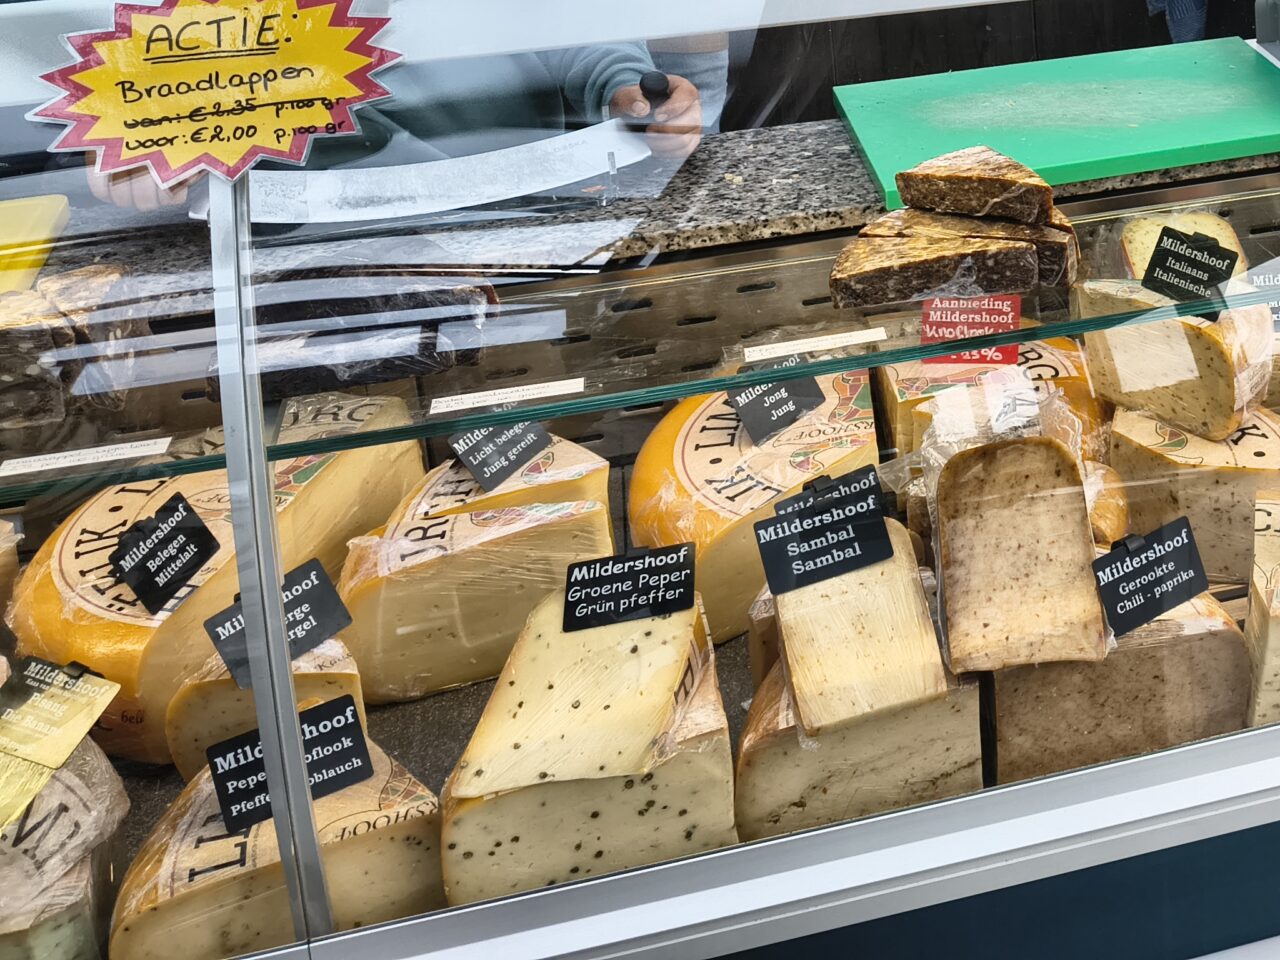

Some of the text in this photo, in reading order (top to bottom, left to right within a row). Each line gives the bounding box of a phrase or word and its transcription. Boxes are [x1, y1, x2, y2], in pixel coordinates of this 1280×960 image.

[145, 7, 298, 55] ACTIE:
[115, 66, 314, 104] Braadlappen
[1160, 236, 1231, 271] Mildershoof
[1165, 257, 1210, 282] Italiaans
[1154, 267, 1213, 298] Italienische
[928, 311, 1015, 324] Mildershoof
[932, 297, 1012, 313] Aanbieding
[763, 386, 788, 408] Jong
[770, 399, 796, 421] Jung
[469, 443, 497, 466] Licht
[483, 432, 538, 478] Jung gereift
[757, 495, 876, 544] Mildershoof
[119, 503, 187, 573] Mildershoof
[146, 533, 187, 573] Belegen
[786, 524, 856, 557] Sambal
[154, 543, 199, 588] Mittelalt
[570, 546, 689, 583] Mildershoof
[791, 542, 862, 575] Sambal
[1096, 528, 1189, 586] Mildershoof
[567, 569, 691, 602] Groene Peper
[1116, 592, 1145, 615] Chili
[1154, 569, 1196, 599] paprika
[1118, 561, 1176, 596] Gerookte
[575, 587, 684, 617] Grün pfeffer
[24, 661, 110, 698] Mildershoof
[27, 692, 69, 718] Pisang
[225, 771, 267, 794] Pepe
